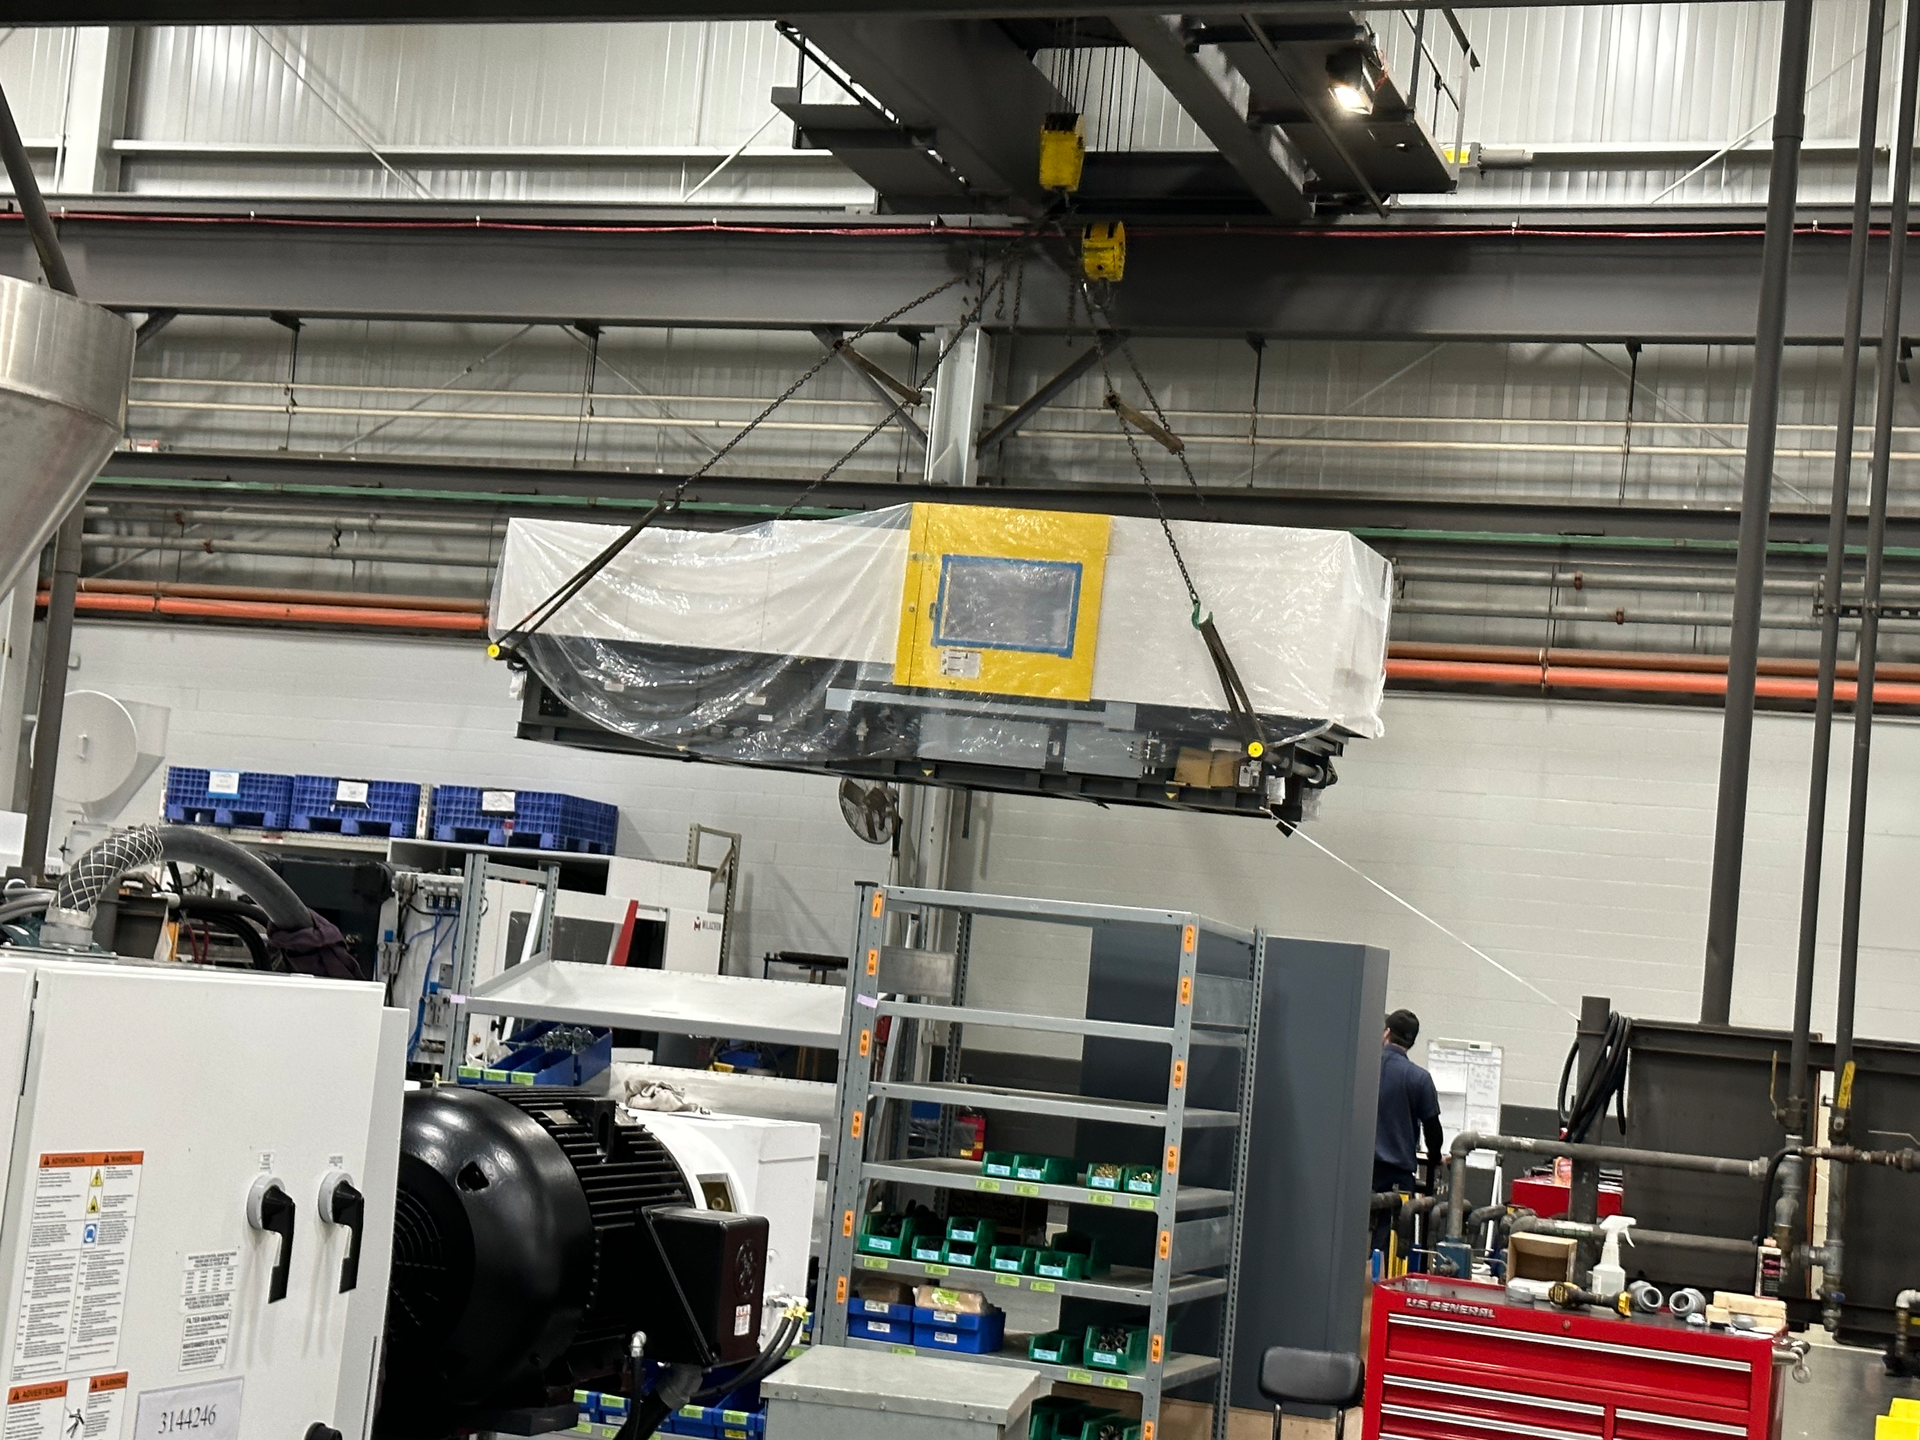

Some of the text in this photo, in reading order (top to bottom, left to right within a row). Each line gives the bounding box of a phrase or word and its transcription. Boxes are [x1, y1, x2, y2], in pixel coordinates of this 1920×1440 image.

[1430, 1301, 1496, 1319] GENERAL
[22, 1386, 63, 1399] ADVERTENCIA
[158, 1403, 217, 1434] 3144246
